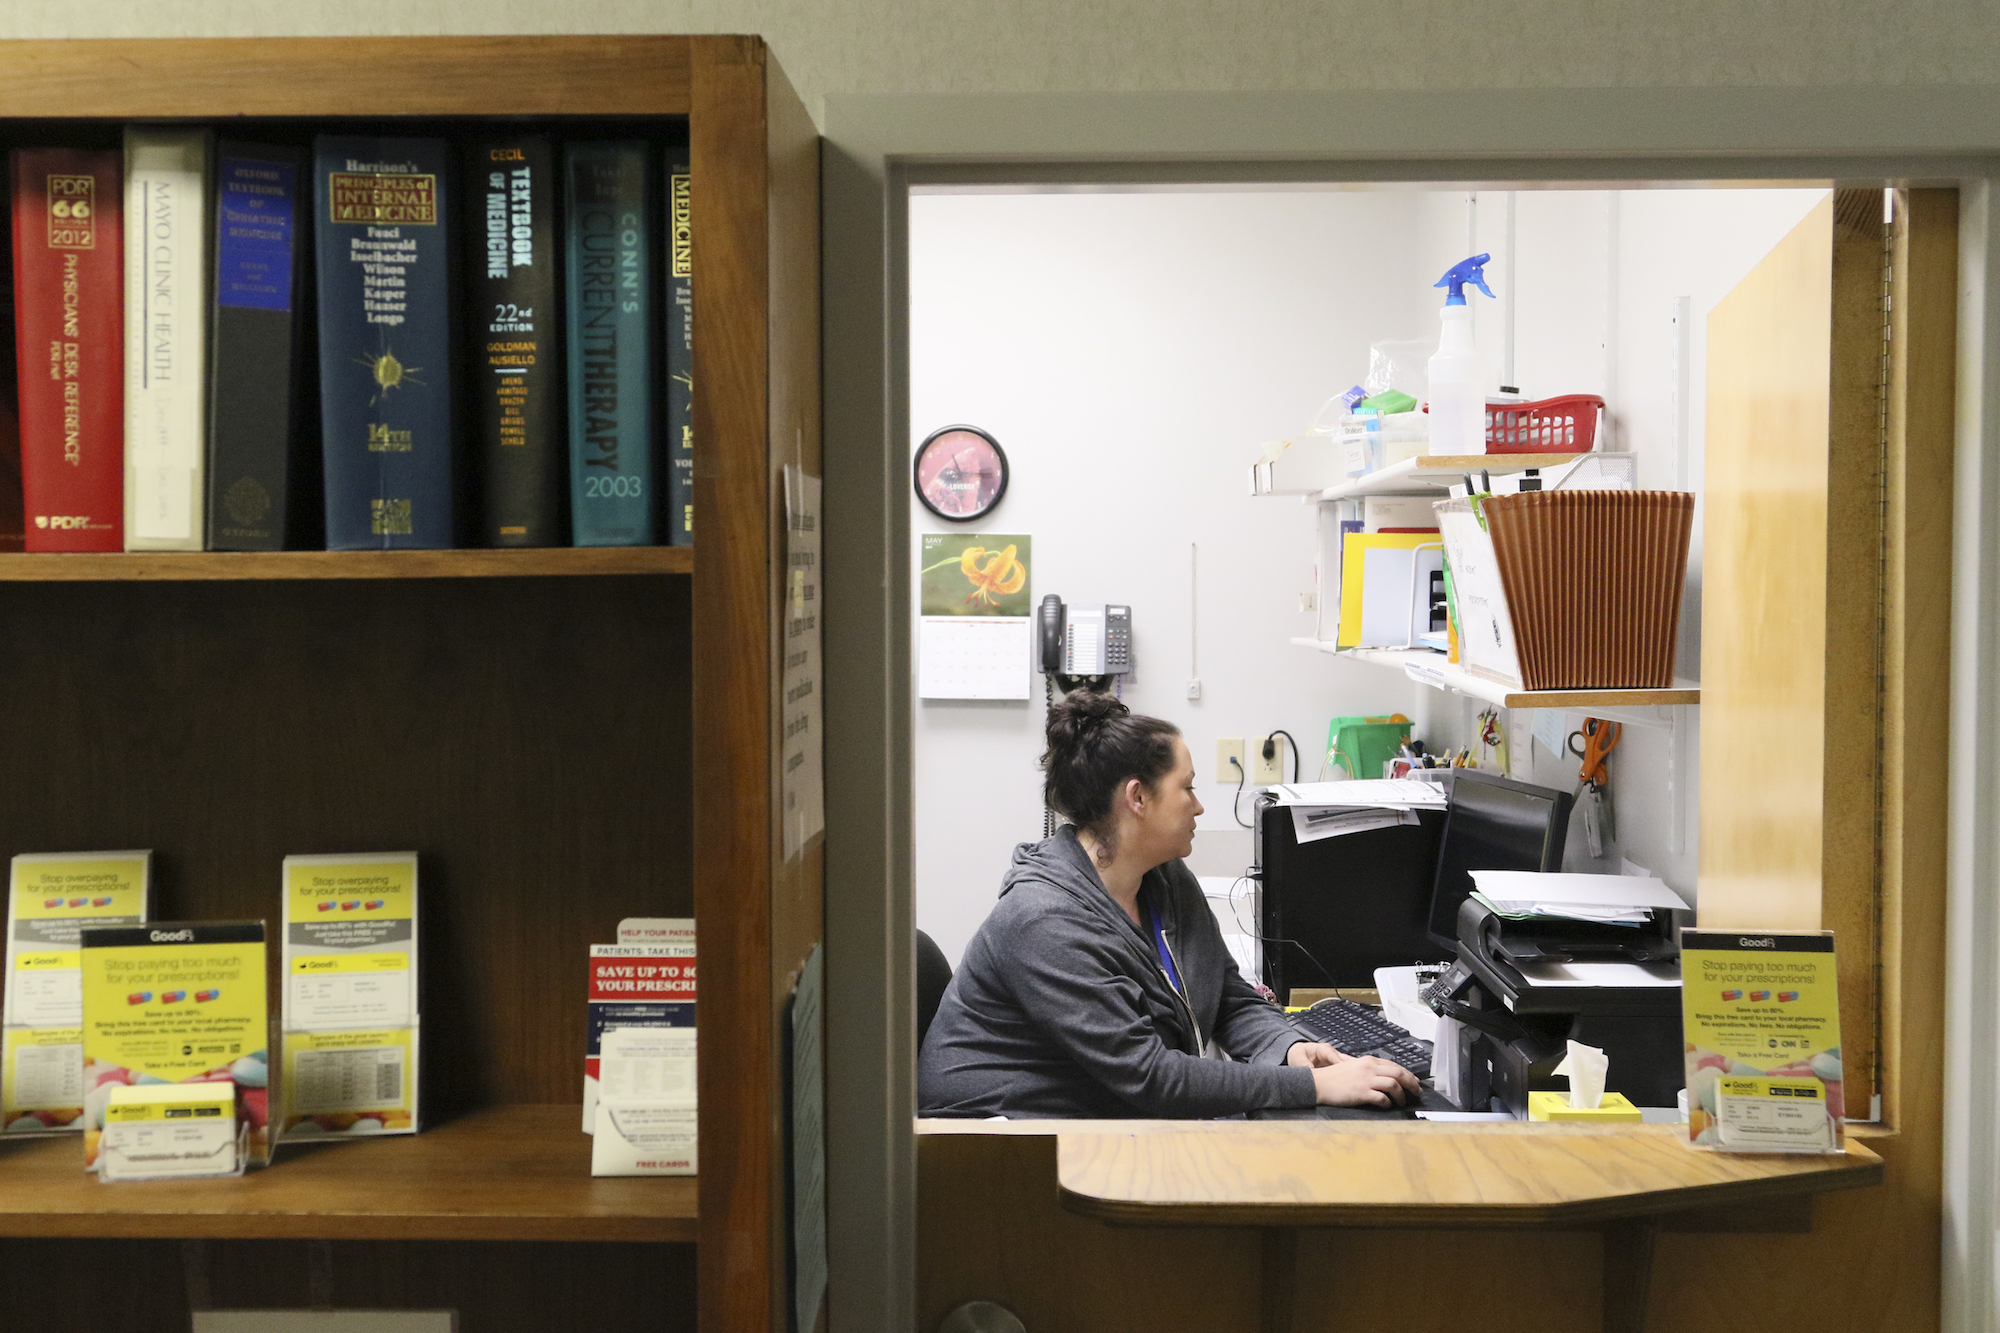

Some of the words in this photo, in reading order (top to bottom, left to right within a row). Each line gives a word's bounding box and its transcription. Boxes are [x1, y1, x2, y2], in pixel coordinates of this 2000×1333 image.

[490, 149, 526, 161] CECIL
[346, 159, 418, 173] Harrison's
[53, 180, 90, 195] PDR
[336, 177, 415, 189] PRINCIPLES
[416, 179, 430, 190] of
[489, 172, 505, 190] OF
[336, 190, 431, 204] INTERNAL
[52, 200, 90, 218] 66
[154, 180, 171, 240] MAYO
[336, 205, 432, 220] MEDICINE
[511, 166, 532, 266] TEXTBOOK
[367, 227, 400, 238] Fauci
[675, 180, 691, 274] MEDICINE
[52, 229, 91, 245] 2012
[487, 193, 508, 279] MEDICINE
[351, 238, 417, 251] Braunwald
[350, 251, 418, 263] Isselbacher
[621, 213, 638, 313] CONN'S
[154, 245, 171, 306] CLINIC
[363, 264, 405, 275] Wilson
[364, 275, 405, 287] Martin
[364, 288, 406, 301] Kasper
[364, 300, 407, 311] Hauser
[367, 312, 405, 326] Longo
[495, 304, 533, 322] 22nd
[489, 323, 534, 332] EDITION
[154, 312, 171, 380] HEALTH
[487, 342, 537, 352] GOLDMAN
[64, 342, 79, 378] DESK
[488, 355, 536, 365] AUSIELLO
[585, 476, 642, 497] 2003
[51, 516, 87, 529] PDR
[40, 874, 64, 884] Stop
[65, 874, 118, 884] overpaying
[312, 877, 335, 887] Stop
[337, 876, 389, 887] overpaying
[27, 884, 40, 893] for
[40, 885, 65, 895] your
[66, 882, 130, 893] prescriptions!
[299, 887, 312, 896] for
[315, 887, 336, 897] your
[338, 884, 402, 896] prescriptions!
[621, 929, 641, 937] HELP
[644, 929, 666, 937] YOUR
[597, 948, 645, 956] PATIENTS:
[647, 948, 670, 956] TAKE
[673, 948, 695, 956] THIS
[105, 958, 135, 972] Stop
[138, 958, 179, 971] paying
[182, 957, 203, 967] too
[206, 956, 241, 967] much
[1702, 960, 1727, 972] Stop
[1730, 961, 1764, 973] paying
[1767, 962, 1784, 972] too
[1787, 962, 1817, 972] much
[106, 973, 123, 984] for
[127, 973, 154, 986] your
[157, 969, 239, 984] prescriptions!
[596, 966, 635, 978] SAVE
[637, 966, 657, 978] UP
[658, 966, 679, 978] TO
[1704, 972, 1719, 981] for
[1721, 973, 1743, 984] your
[1746, 974, 1816, 984] prescriptions!
[596, 980, 635, 992] YOUR
[1696, 1013, 1713, 1021] Bring
[1781, 1039, 1797, 1048] CNN
[636, 1161, 658, 1169] FREE
[659, 1160, 690, 1168] CARDS
